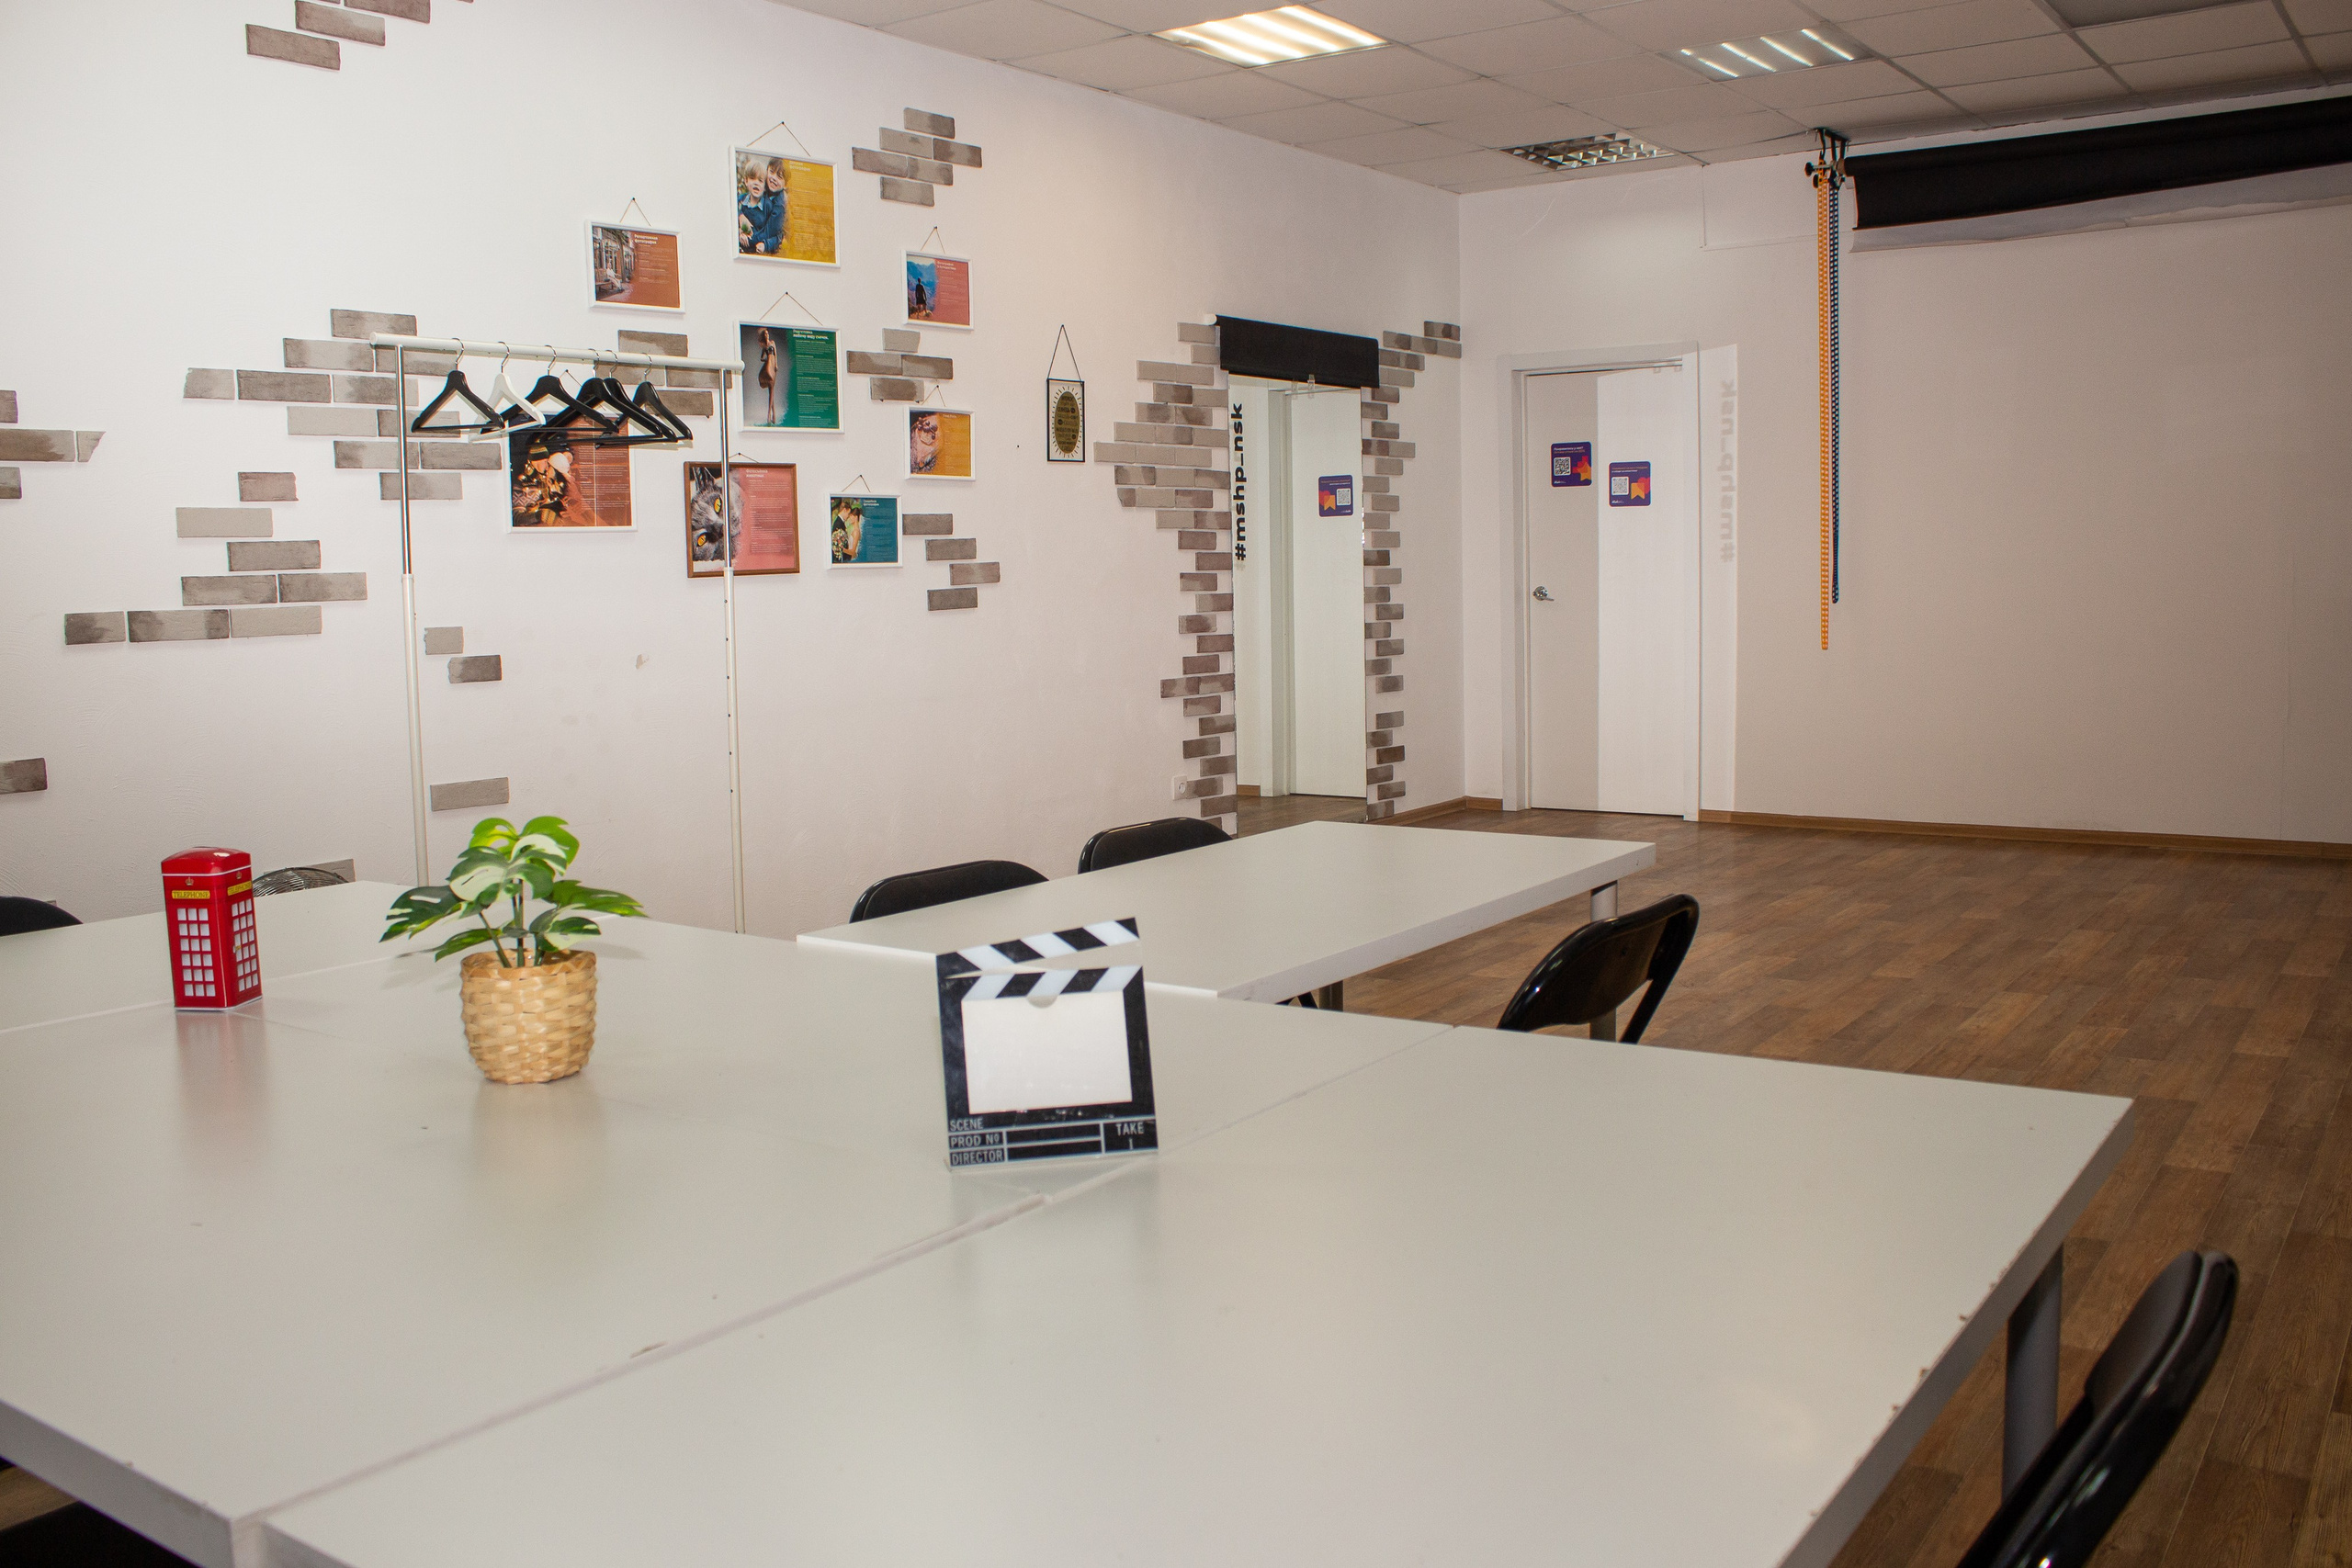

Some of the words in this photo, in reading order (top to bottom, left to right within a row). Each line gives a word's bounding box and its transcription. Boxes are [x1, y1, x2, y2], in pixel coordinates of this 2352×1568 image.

[1231, 403, 1247, 561] #mshp_nsk
[229, 882, 252, 894] TELEPHONE
[949, 1118, 984, 1132] SCENE
[1116, 1122, 1145, 1135] TAKE
[950, 1135, 982, 1148] PROD
[951, 1149, 1003, 1166] DIRECTOR
